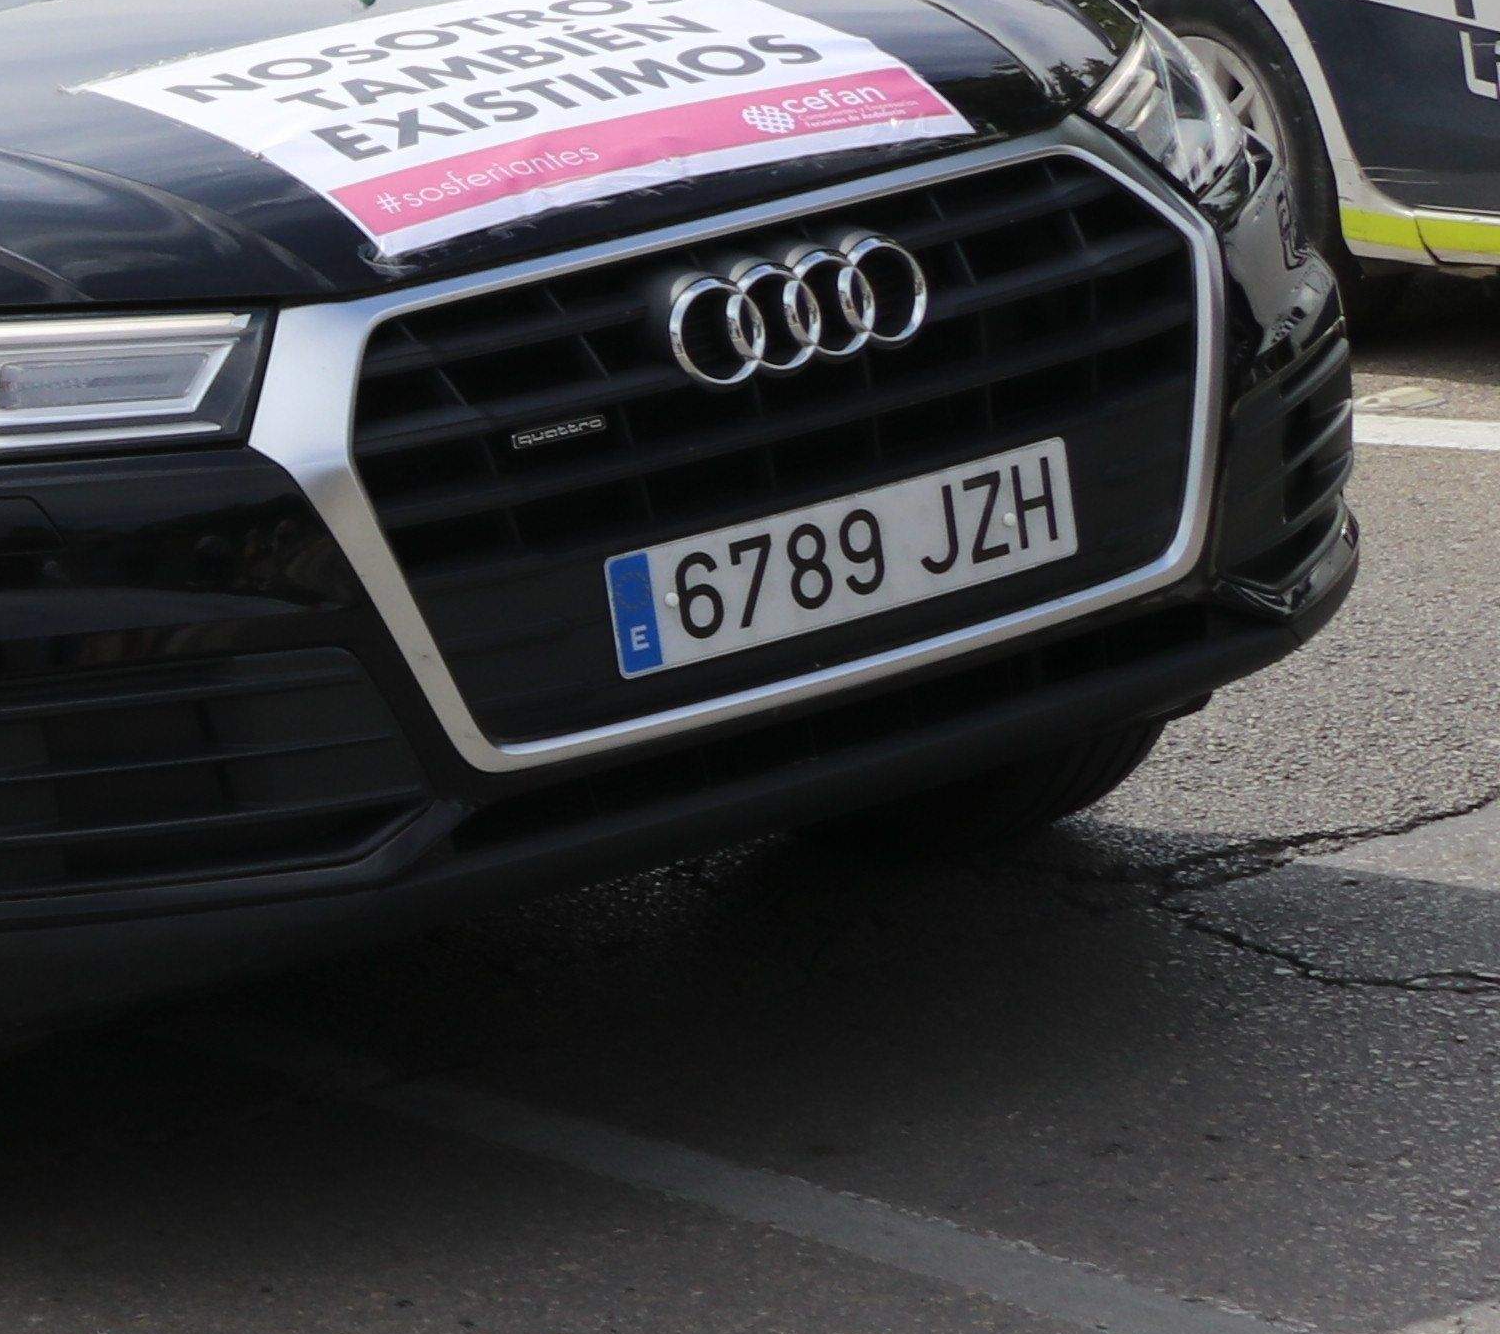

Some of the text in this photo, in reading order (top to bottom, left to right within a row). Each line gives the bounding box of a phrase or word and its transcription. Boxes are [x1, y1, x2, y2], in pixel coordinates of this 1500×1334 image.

[274, 15, 720, 110] TAMBIÉN
[310, 34, 824, 161] EXISTIMOS
[781, 86, 887, 113] cefan
[375, 144, 600, 216] #sosferiantes
[516, 415, 604, 447] quattro
[674, 457, 1059, 639] 6789 JZH
